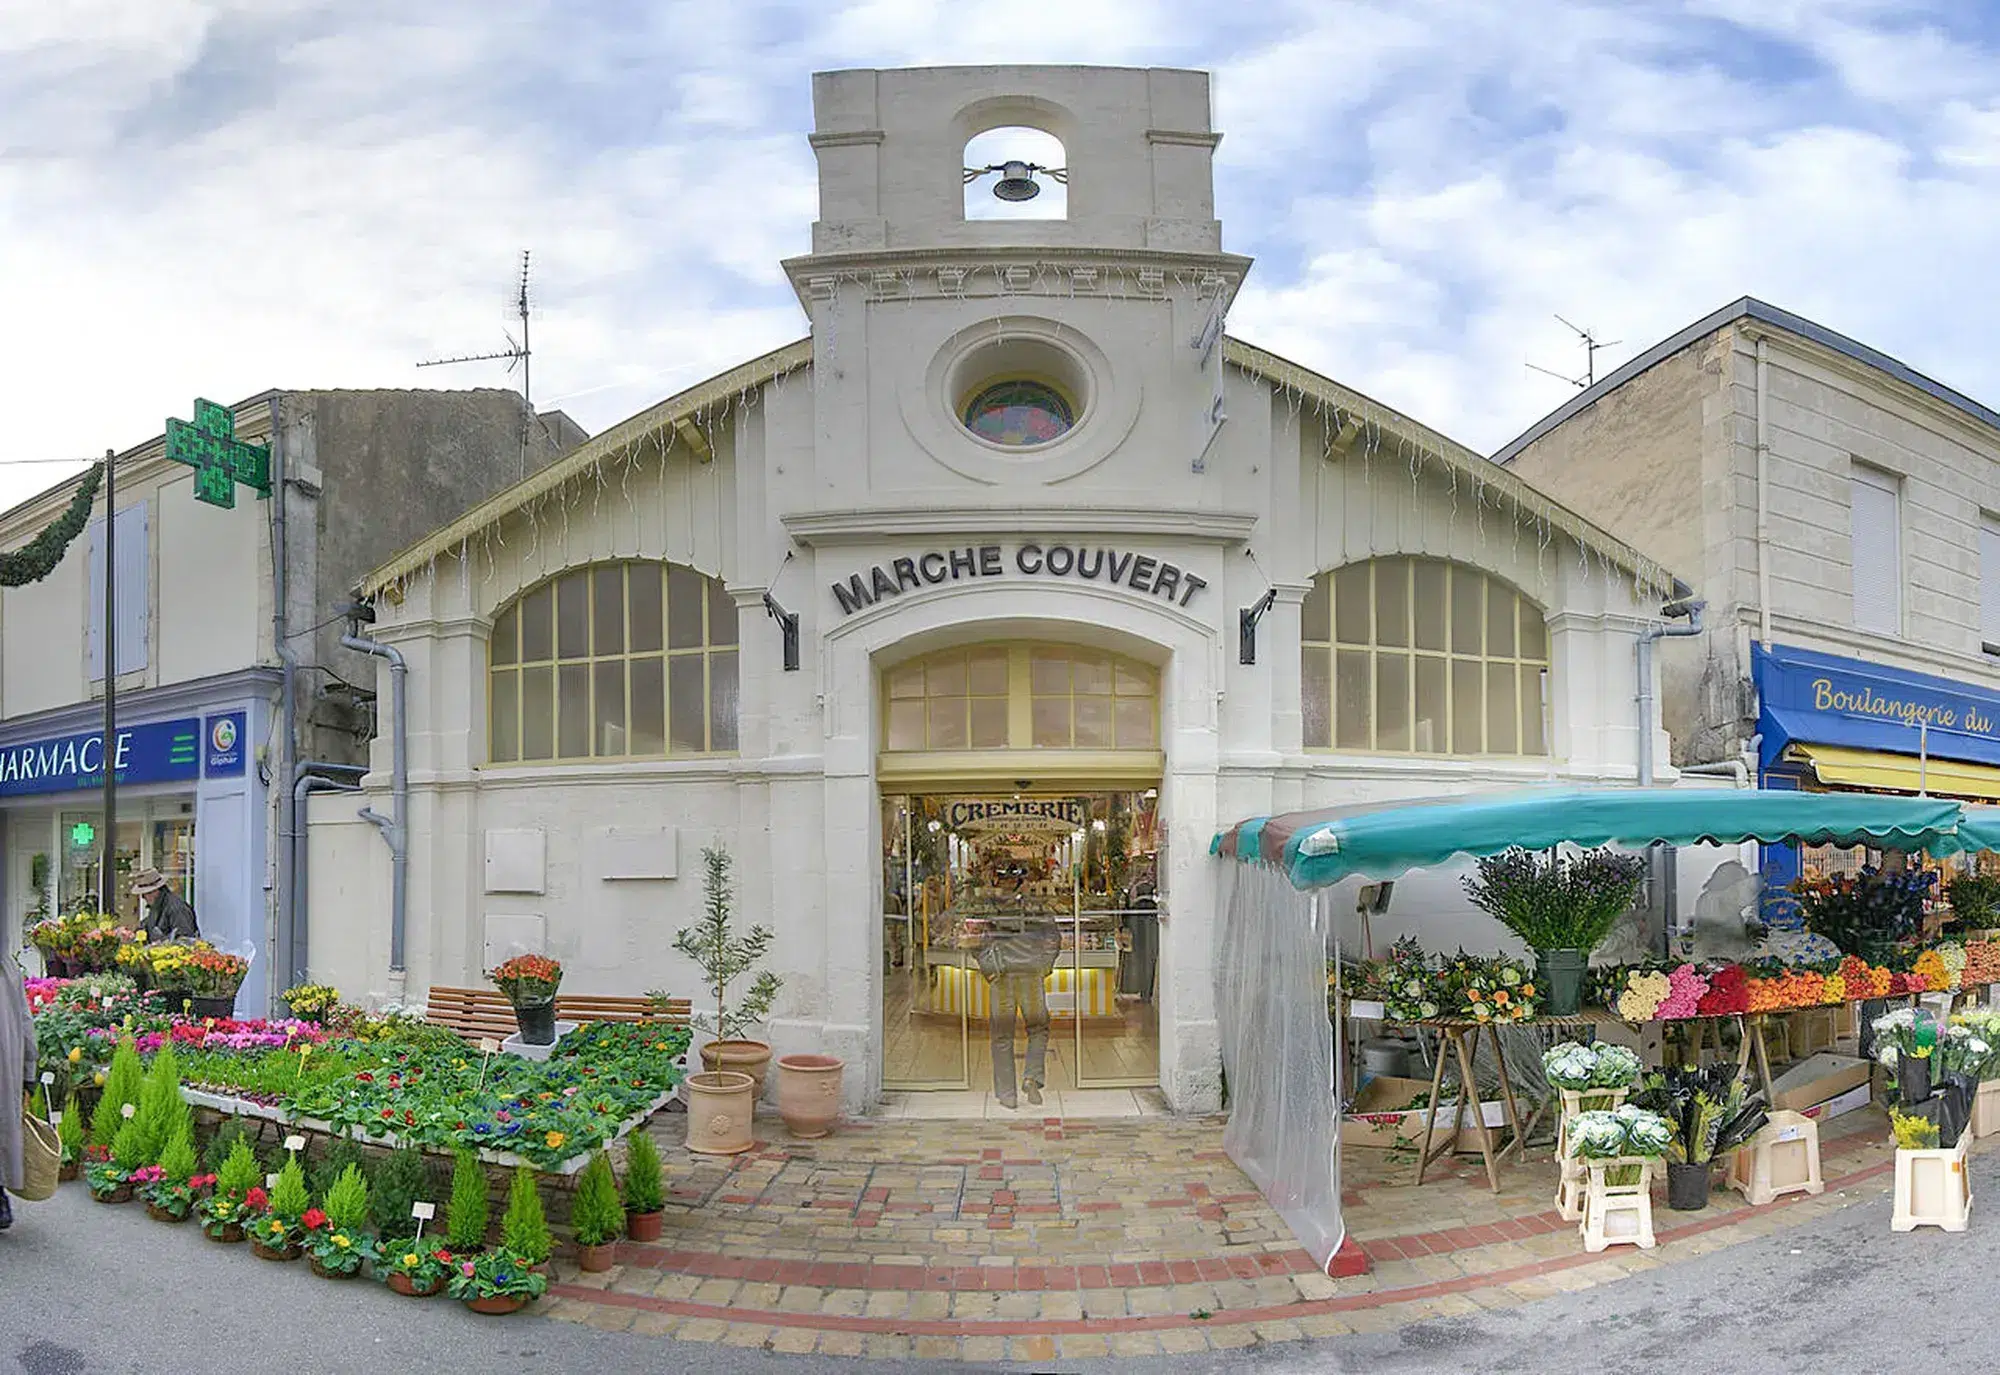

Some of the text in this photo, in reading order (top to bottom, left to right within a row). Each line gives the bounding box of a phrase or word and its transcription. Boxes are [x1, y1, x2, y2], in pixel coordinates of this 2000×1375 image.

[831, 544, 1207, 615] MARCHE COUVERT
[1811, 677, 1993, 733] Boulangerie du
[0, 732, 132, 782] ARMACE
[951, 801, 1083, 827] CREMERIE
